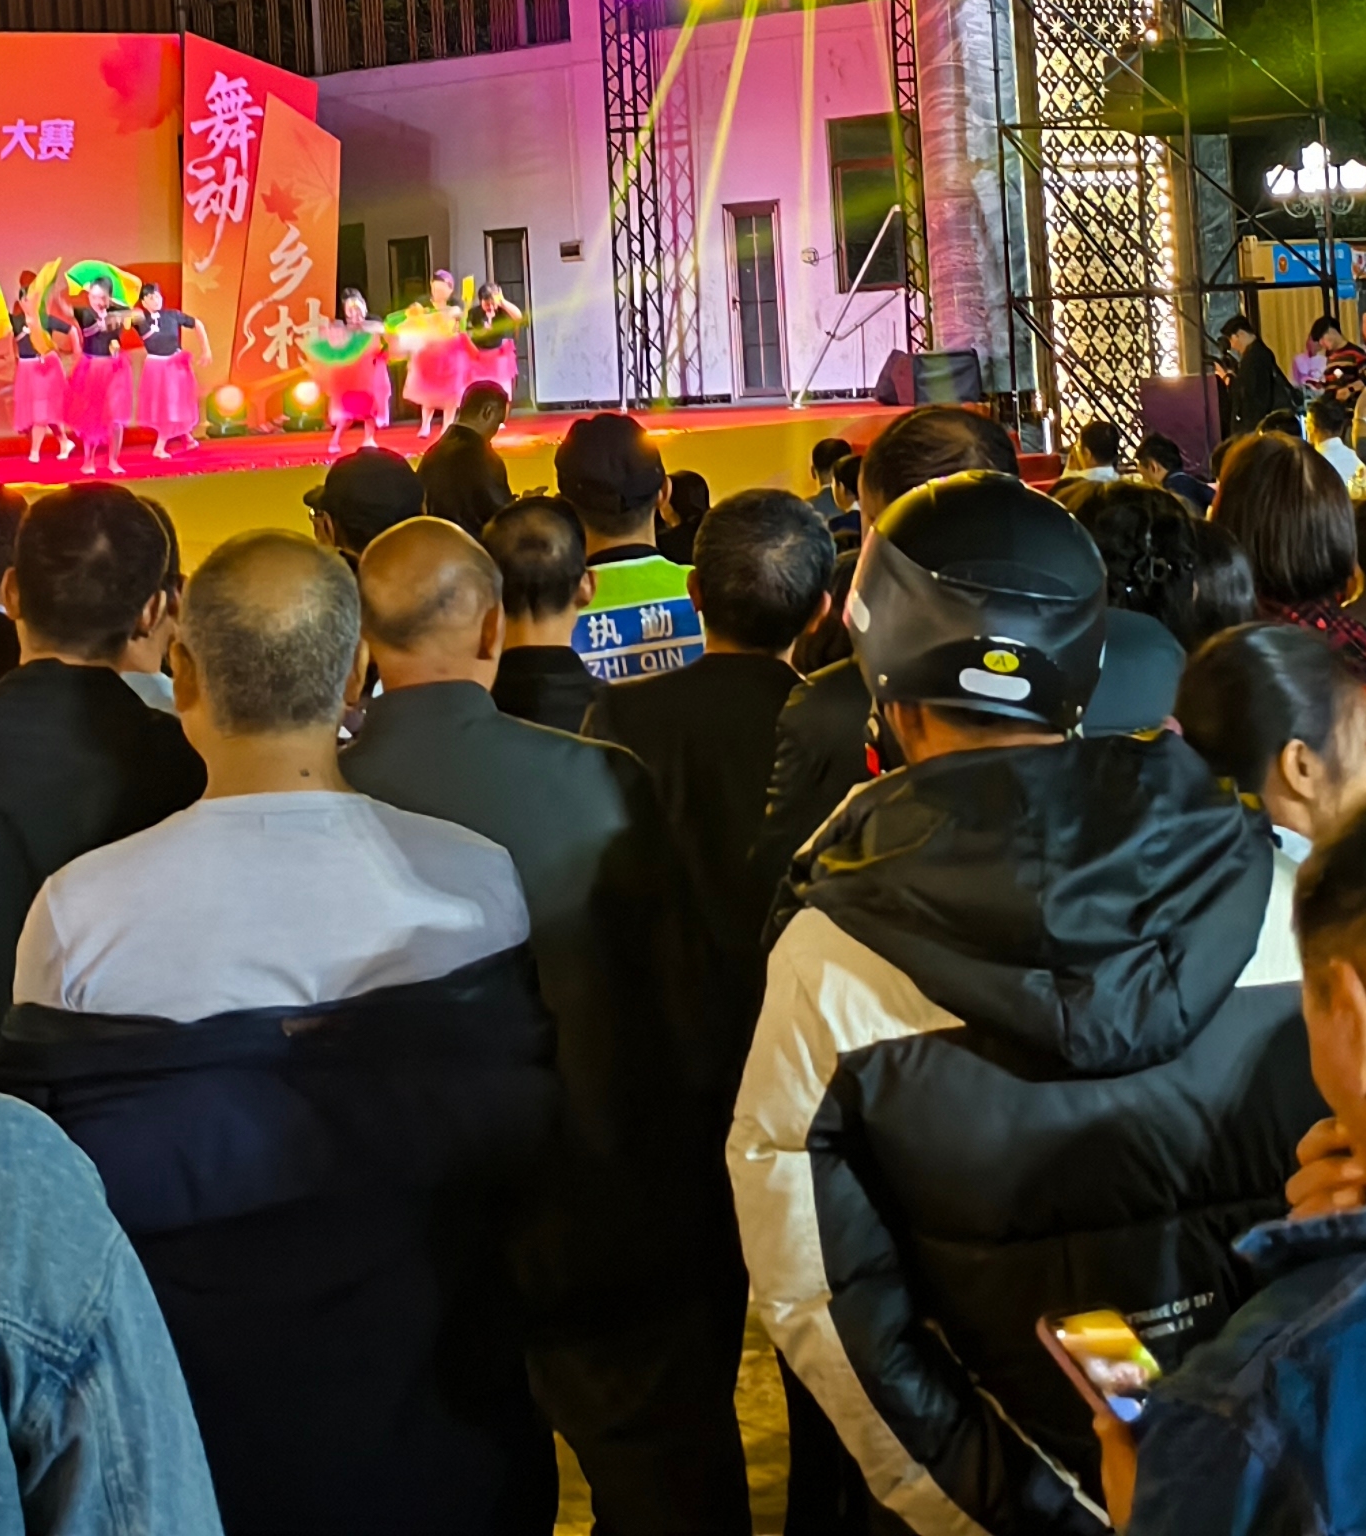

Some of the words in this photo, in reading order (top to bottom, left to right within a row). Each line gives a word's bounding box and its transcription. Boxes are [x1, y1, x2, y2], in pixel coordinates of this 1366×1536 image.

[186, 70, 264, 275] 舞动
[588, 603, 674, 649] 执勤
[589, 658, 629, 681] ZHI
[641, 646, 685, 673] QIN
